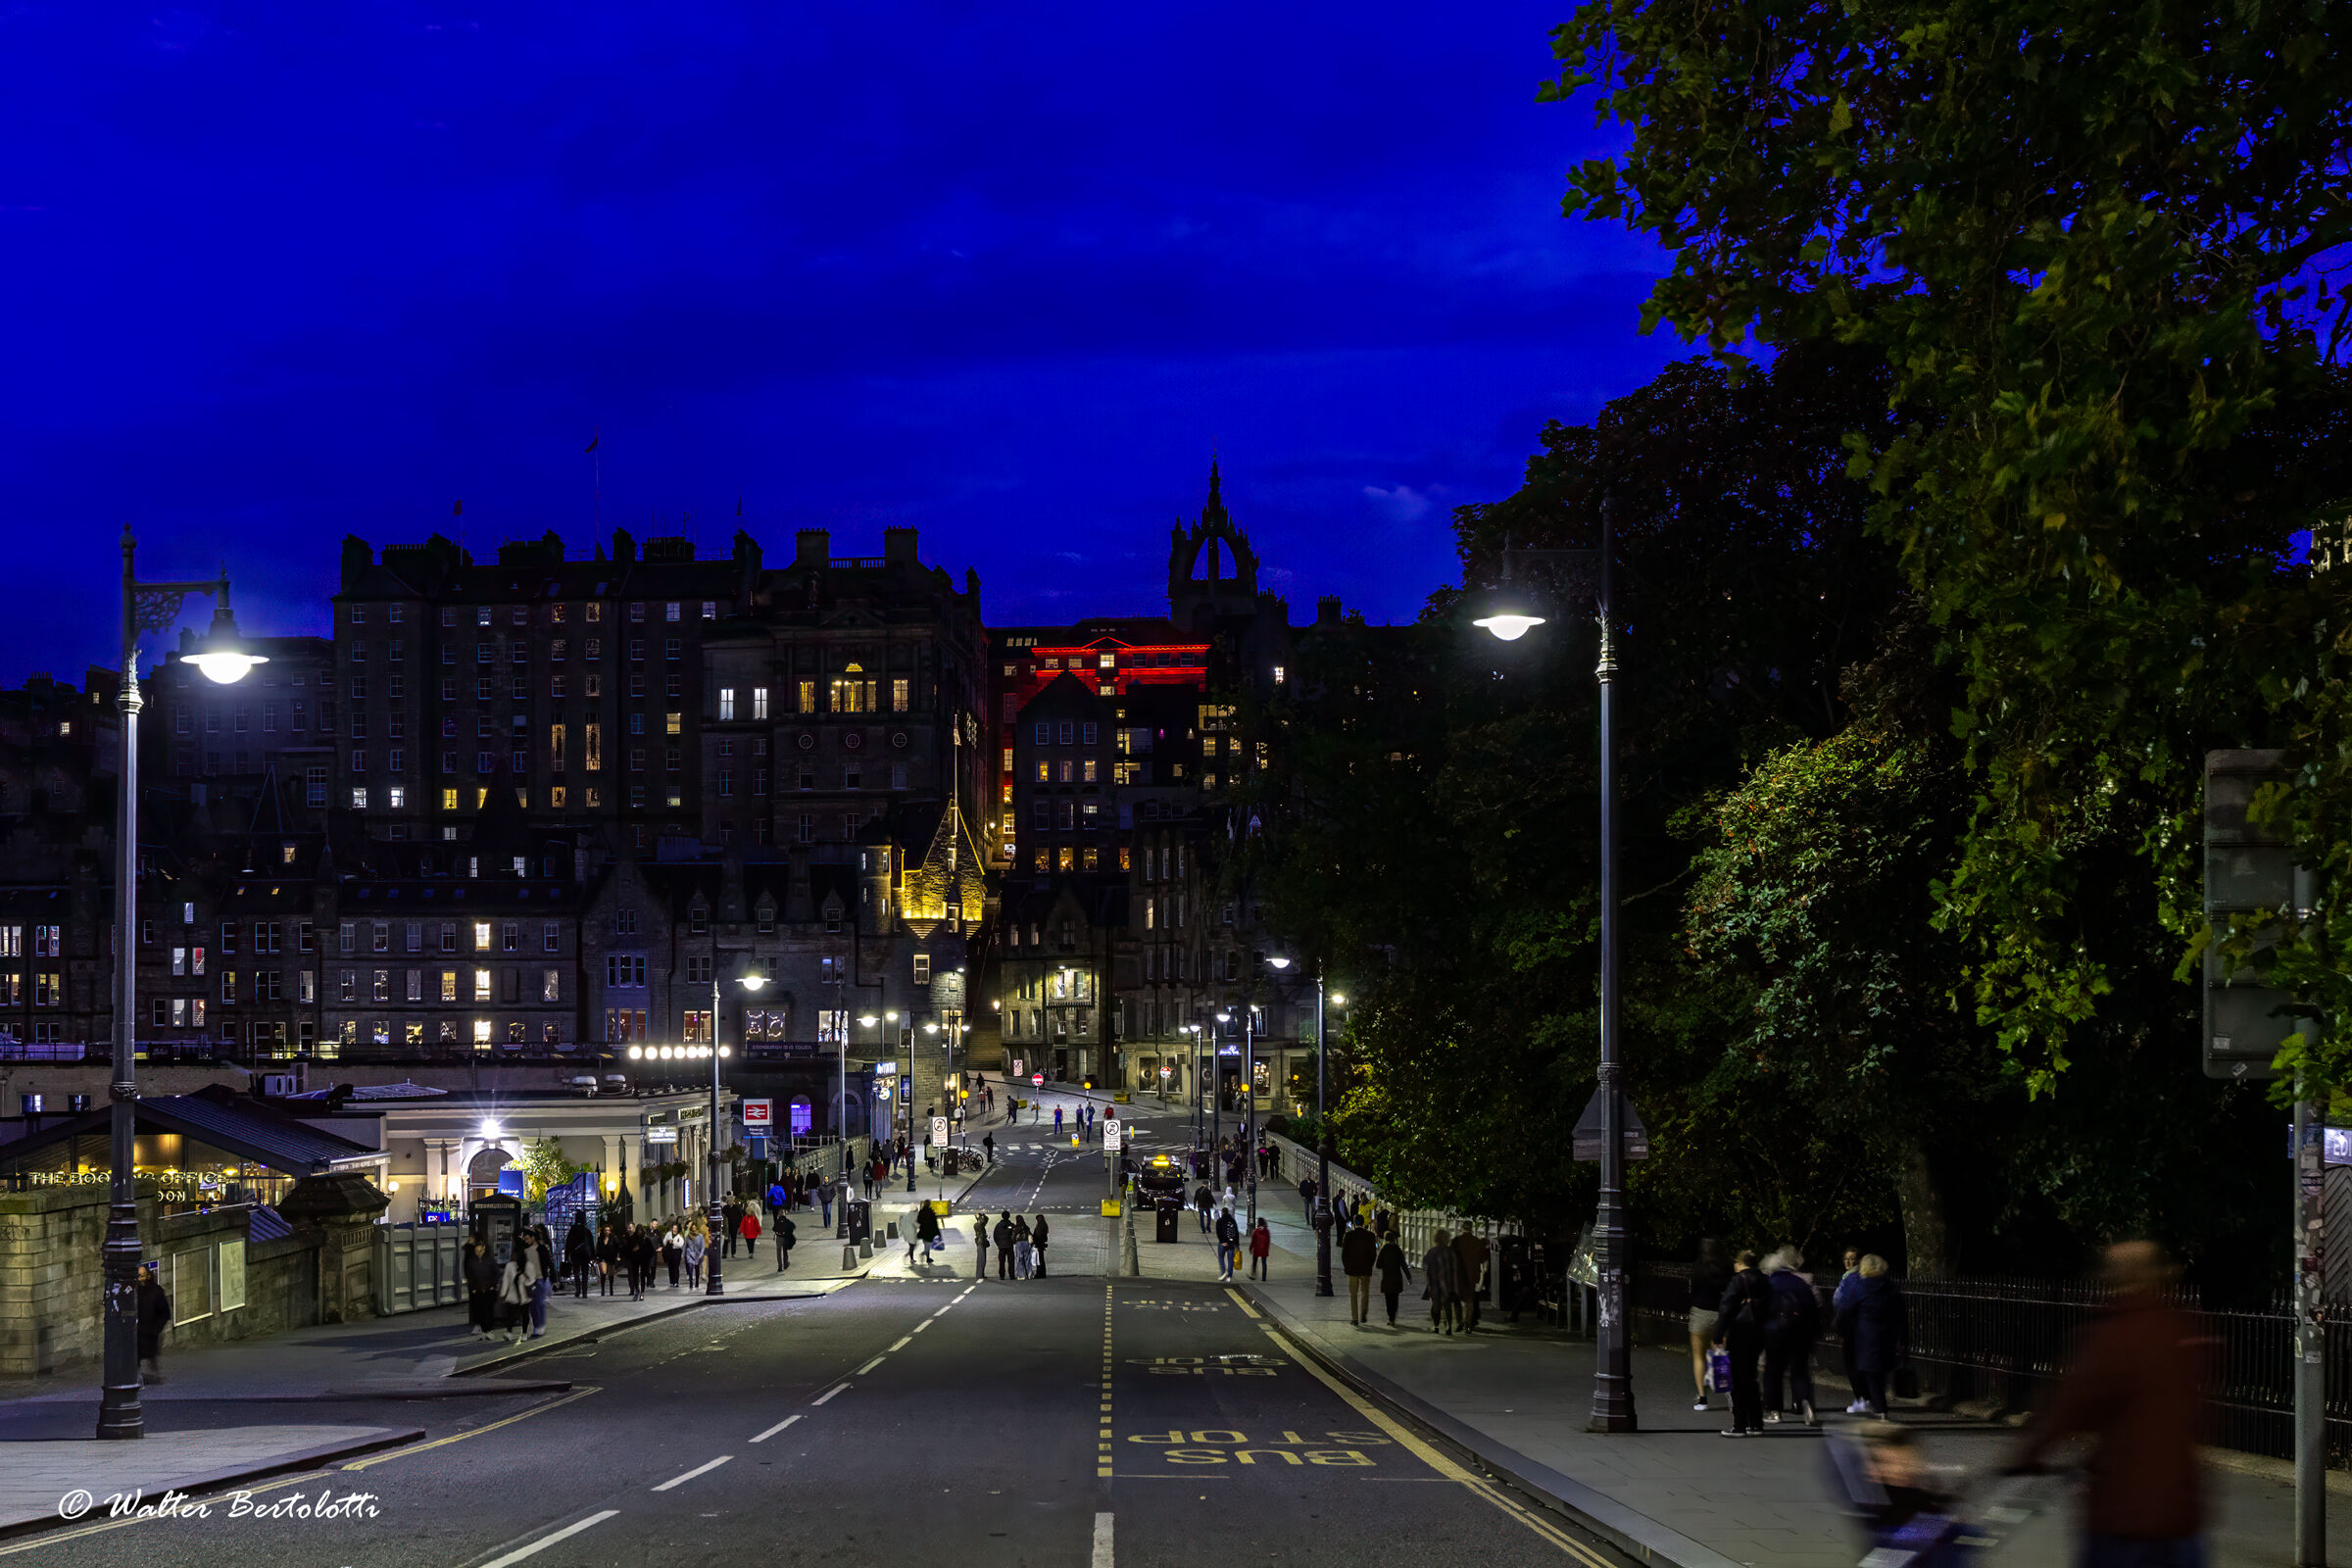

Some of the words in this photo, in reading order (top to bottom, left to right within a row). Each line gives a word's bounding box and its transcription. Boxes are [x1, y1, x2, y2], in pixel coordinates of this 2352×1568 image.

[28, 1172, 65, 1184] THE
[161, 1172, 225, 1185] OFFICE
[1128, 1430, 1393, 1445] STOP
[1164, 1448, 1377, 1466] BUS
